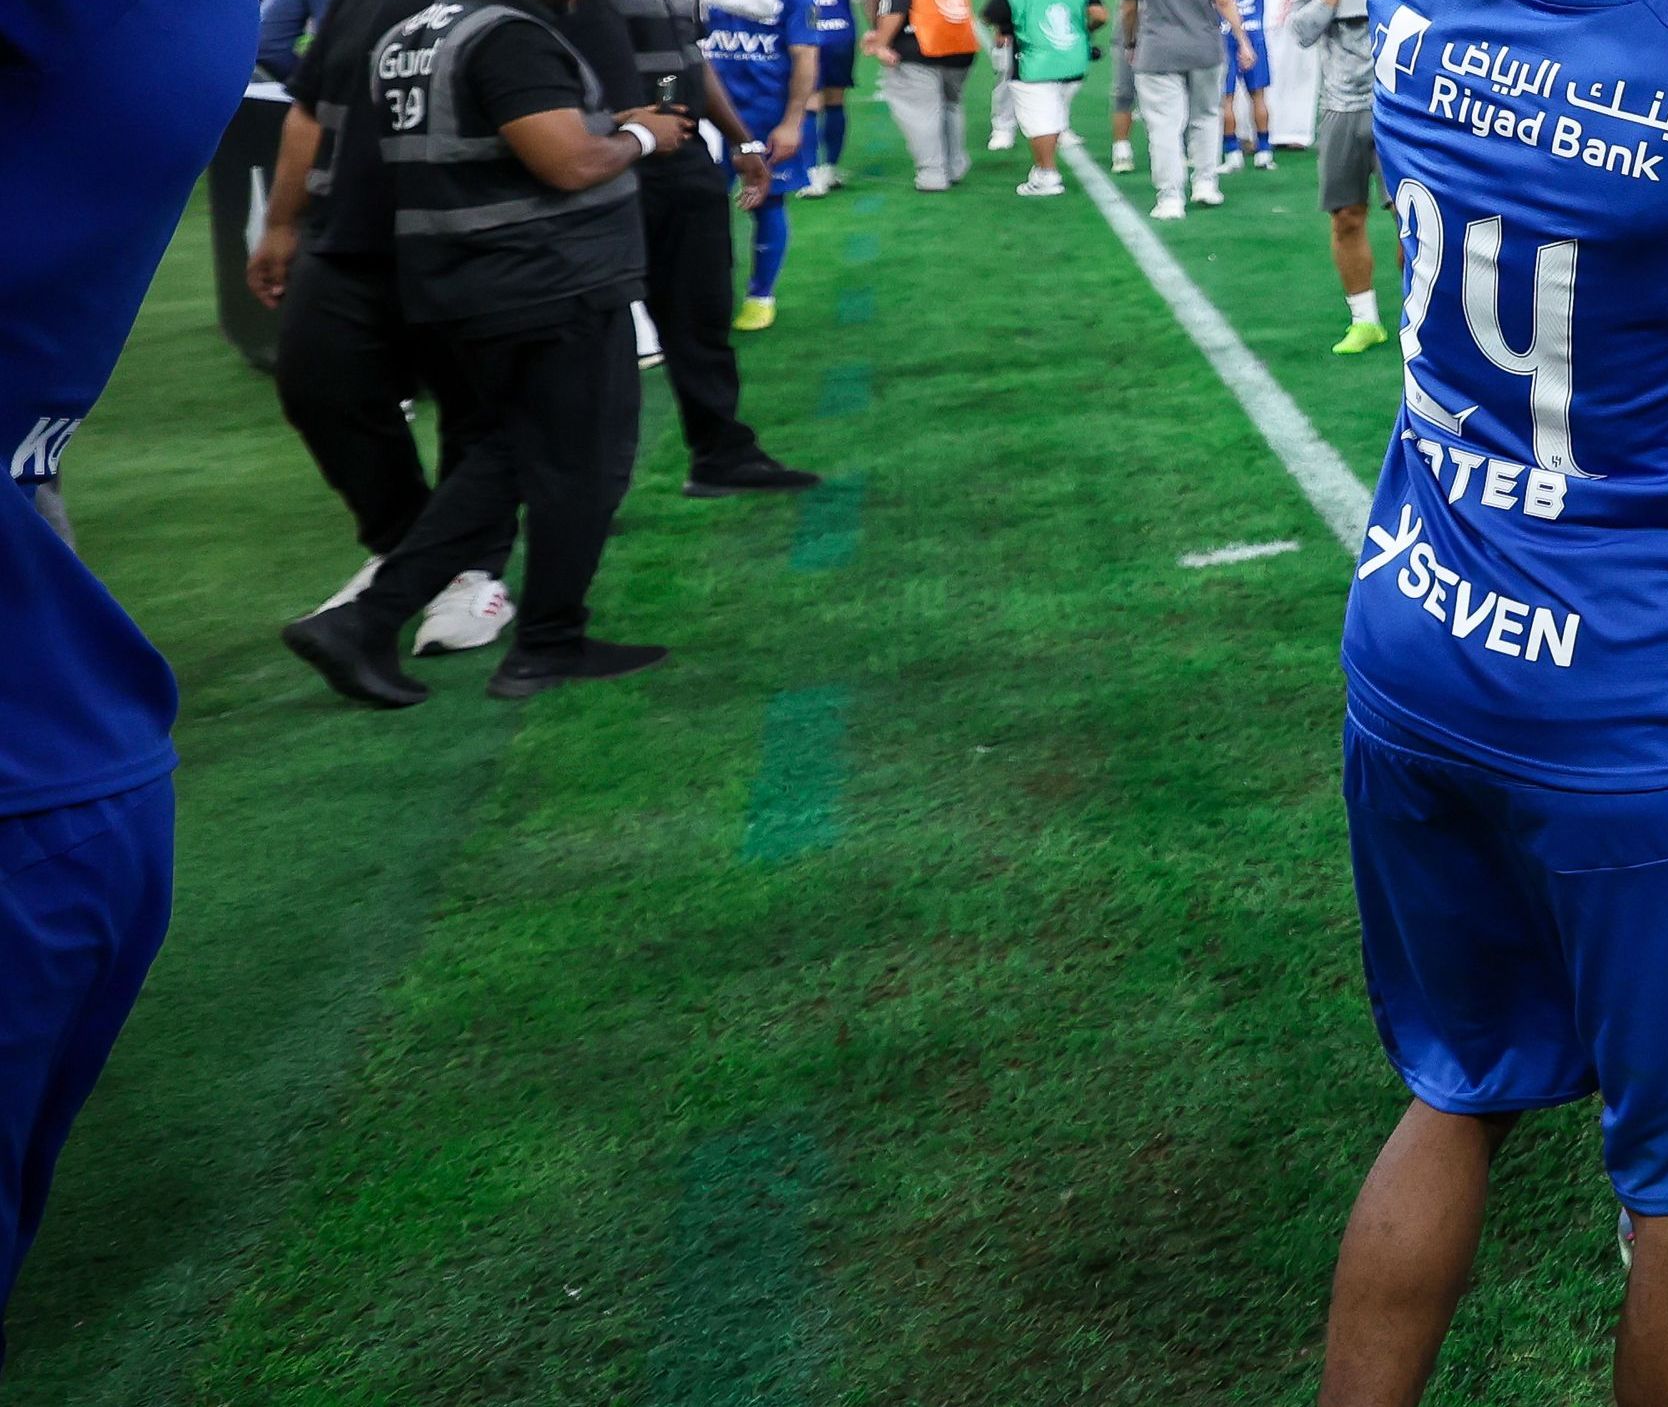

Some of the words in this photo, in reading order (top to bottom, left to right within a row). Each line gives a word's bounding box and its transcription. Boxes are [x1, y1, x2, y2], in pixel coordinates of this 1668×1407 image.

[384, 86, 426, 131] 39
[1441, 41, 1561, 98] الرياض
[1428, 75, 1546, 147] Riyad
[1551, 115, 1664, 182] Bank
[1395, 178, 1608, 480] 24
[1401, 428, 1568, 521] TEB
